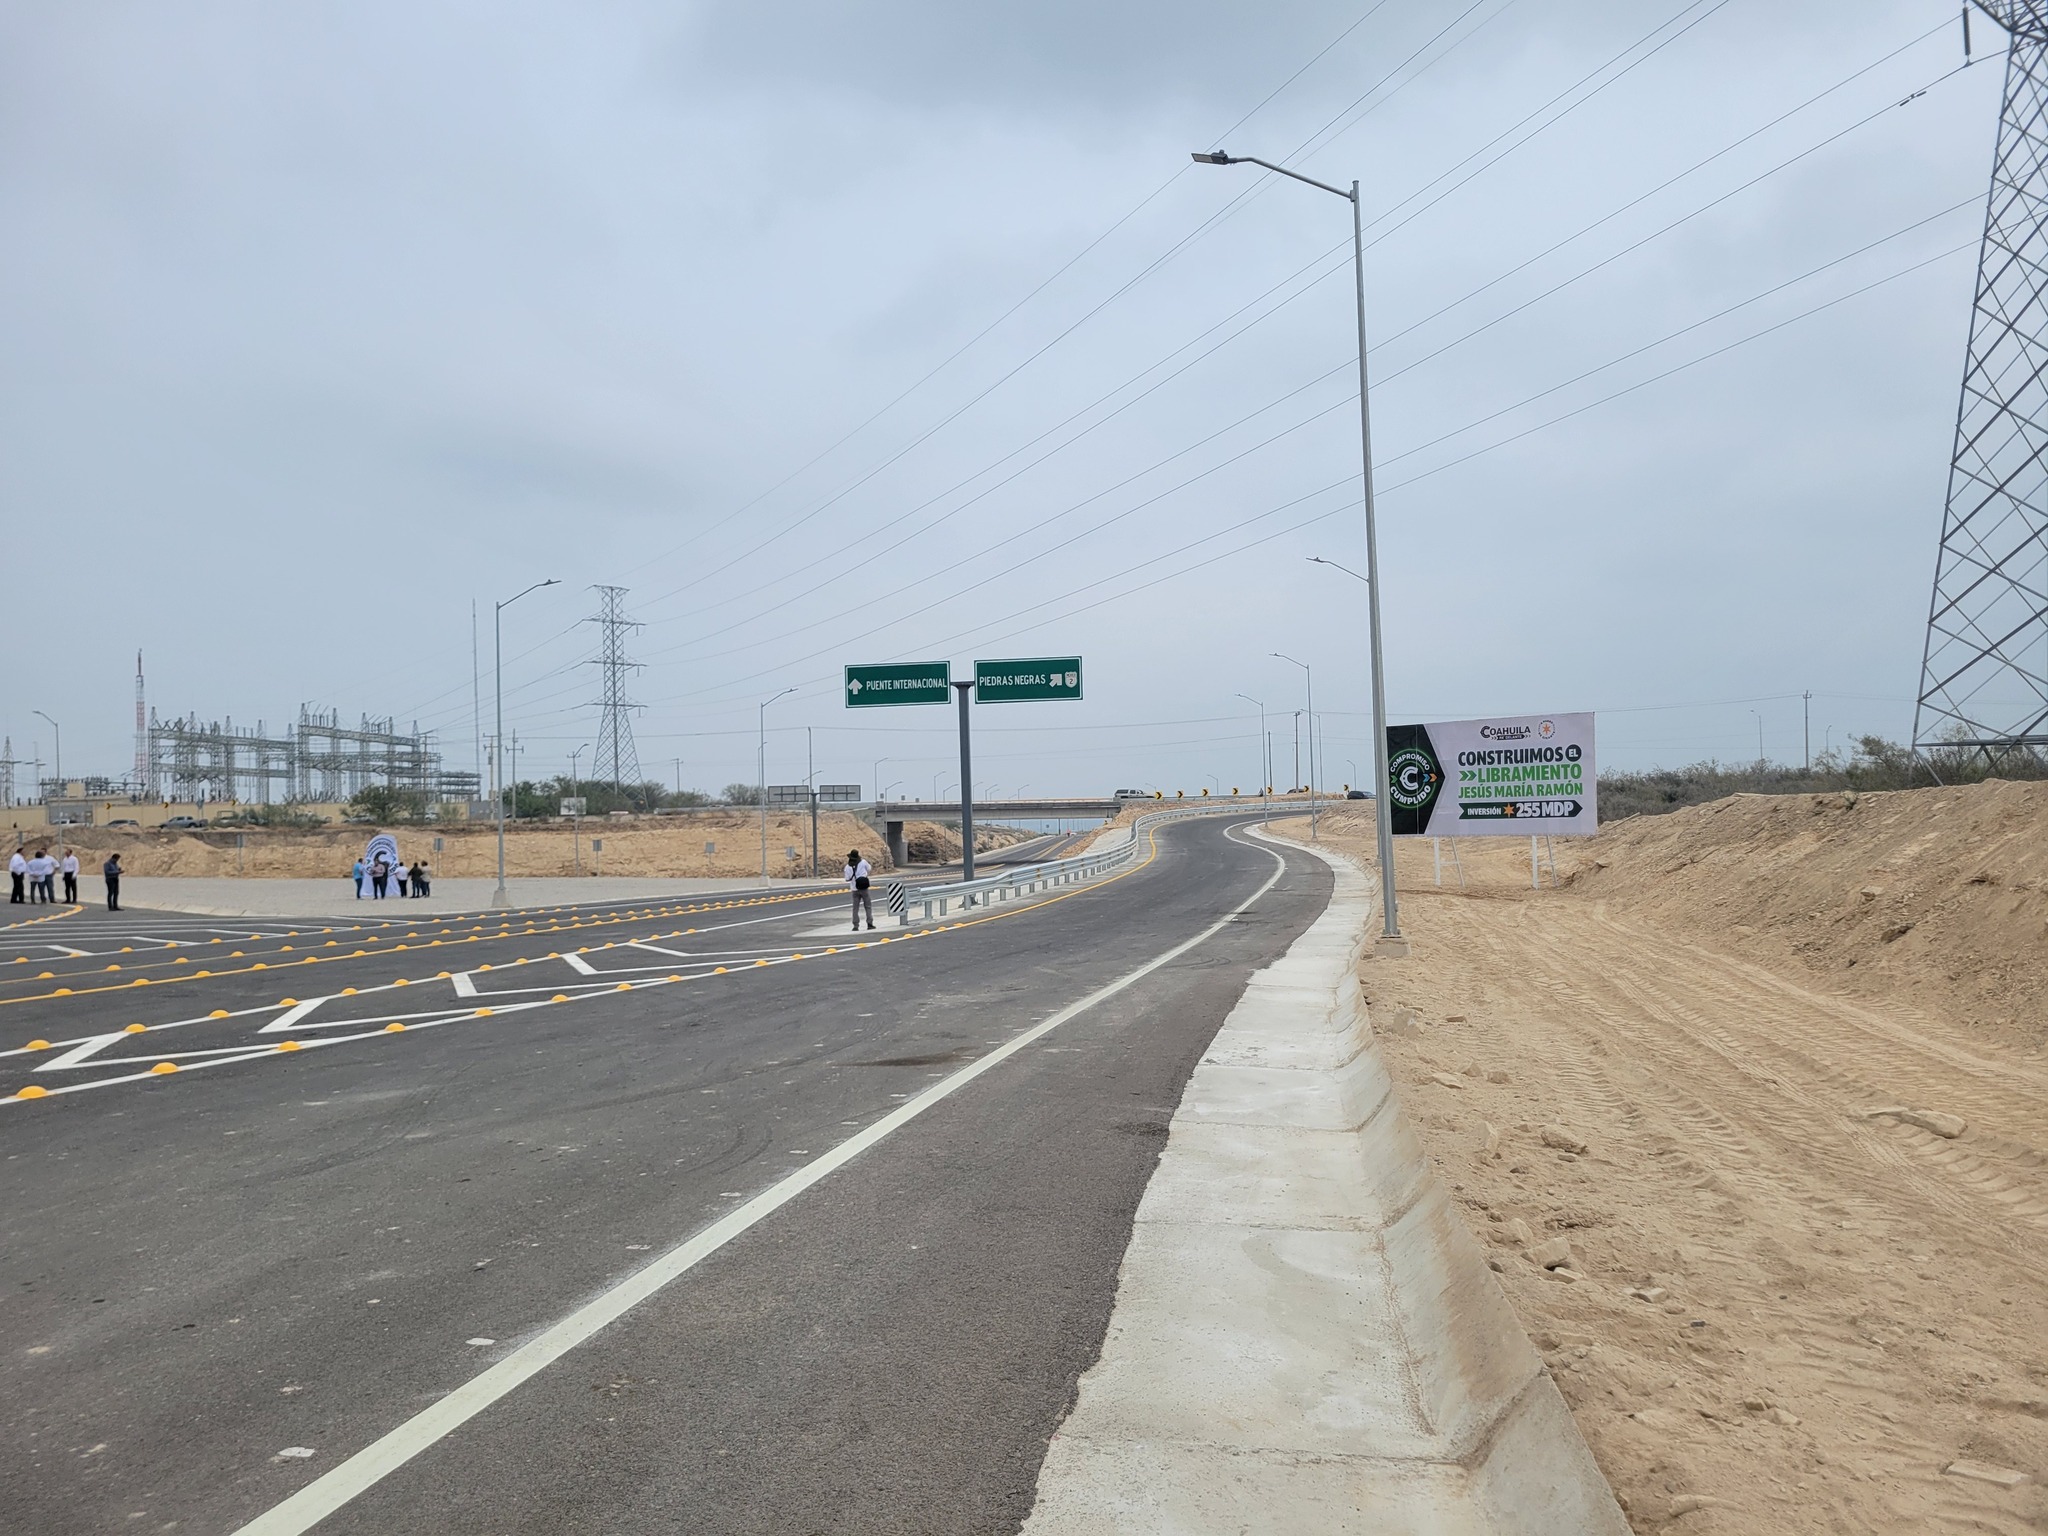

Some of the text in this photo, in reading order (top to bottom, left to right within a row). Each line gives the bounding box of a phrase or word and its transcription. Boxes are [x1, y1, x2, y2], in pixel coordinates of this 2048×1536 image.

[866, 677, 947, 691] PUENTE INTERNACIONAL
[979, 674, 1046, 686] PIEDRAS NEGRAS
[1480, 725, 1531, 738] COAHUILA
[1390, 753, 1430, 772] COMPROMISO
[1458, 746, 1578, 766] CONSTRUIMOS EL
[1477, 763, 1582, 782] LIBRAMIENTO
[1390, 785, 1431, 804] CUMPLIDO
[1458, 780, 1583, 798] JESÚS MARÍA RAMÓN
[1467, 801, 1574, 817] INVERSIÓN 255 MDP
